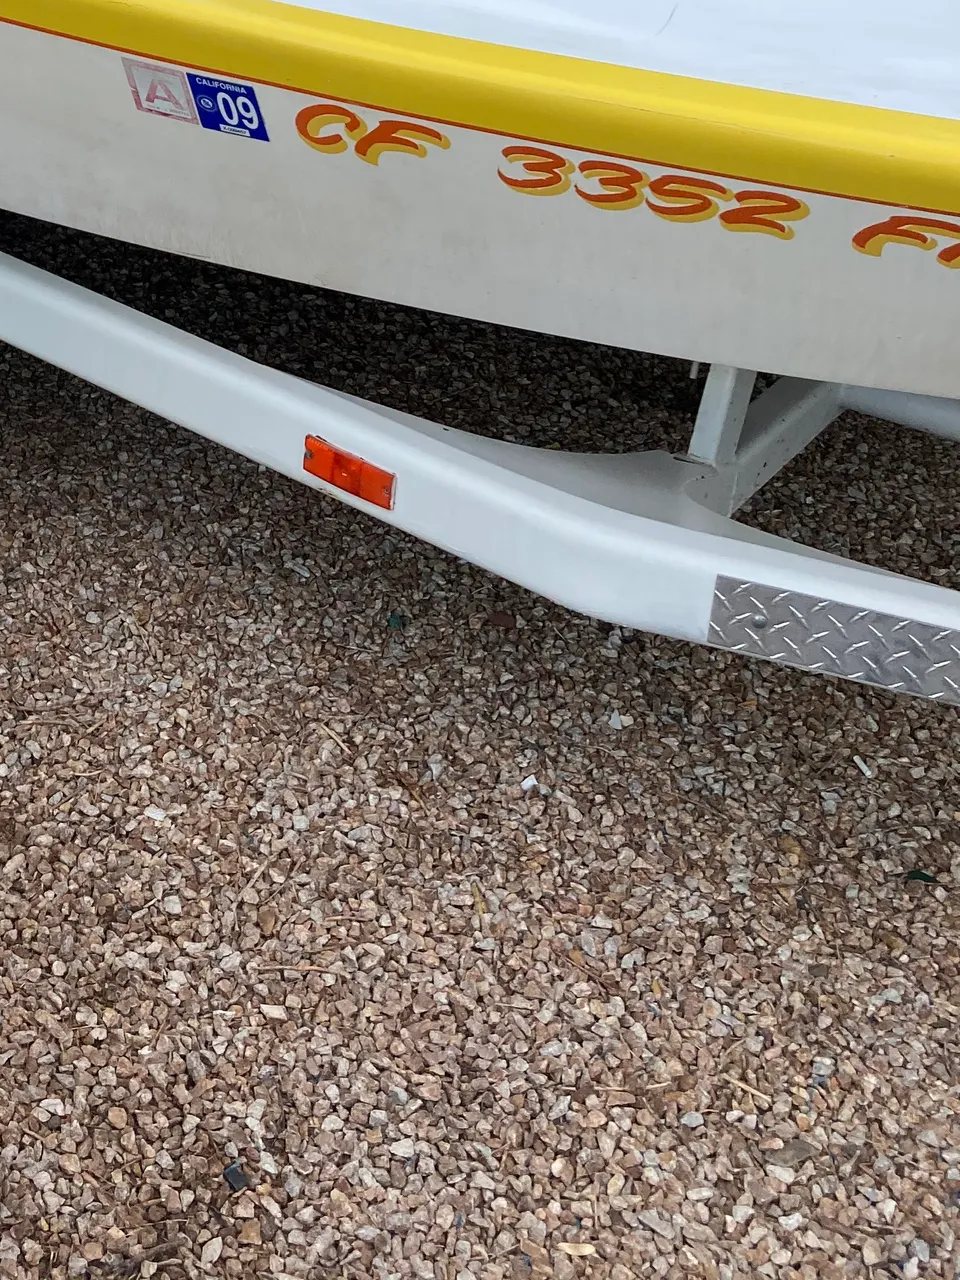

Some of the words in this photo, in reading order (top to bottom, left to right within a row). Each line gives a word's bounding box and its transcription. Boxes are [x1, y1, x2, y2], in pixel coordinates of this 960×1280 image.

[145, 78, 184, 110] A
[196, 77, 247, 94] CALIFORNIA
[217, 92, 259, 130] 09
[295, 104, 451, 166] CF
[497, 146, 810, 240] 3352
